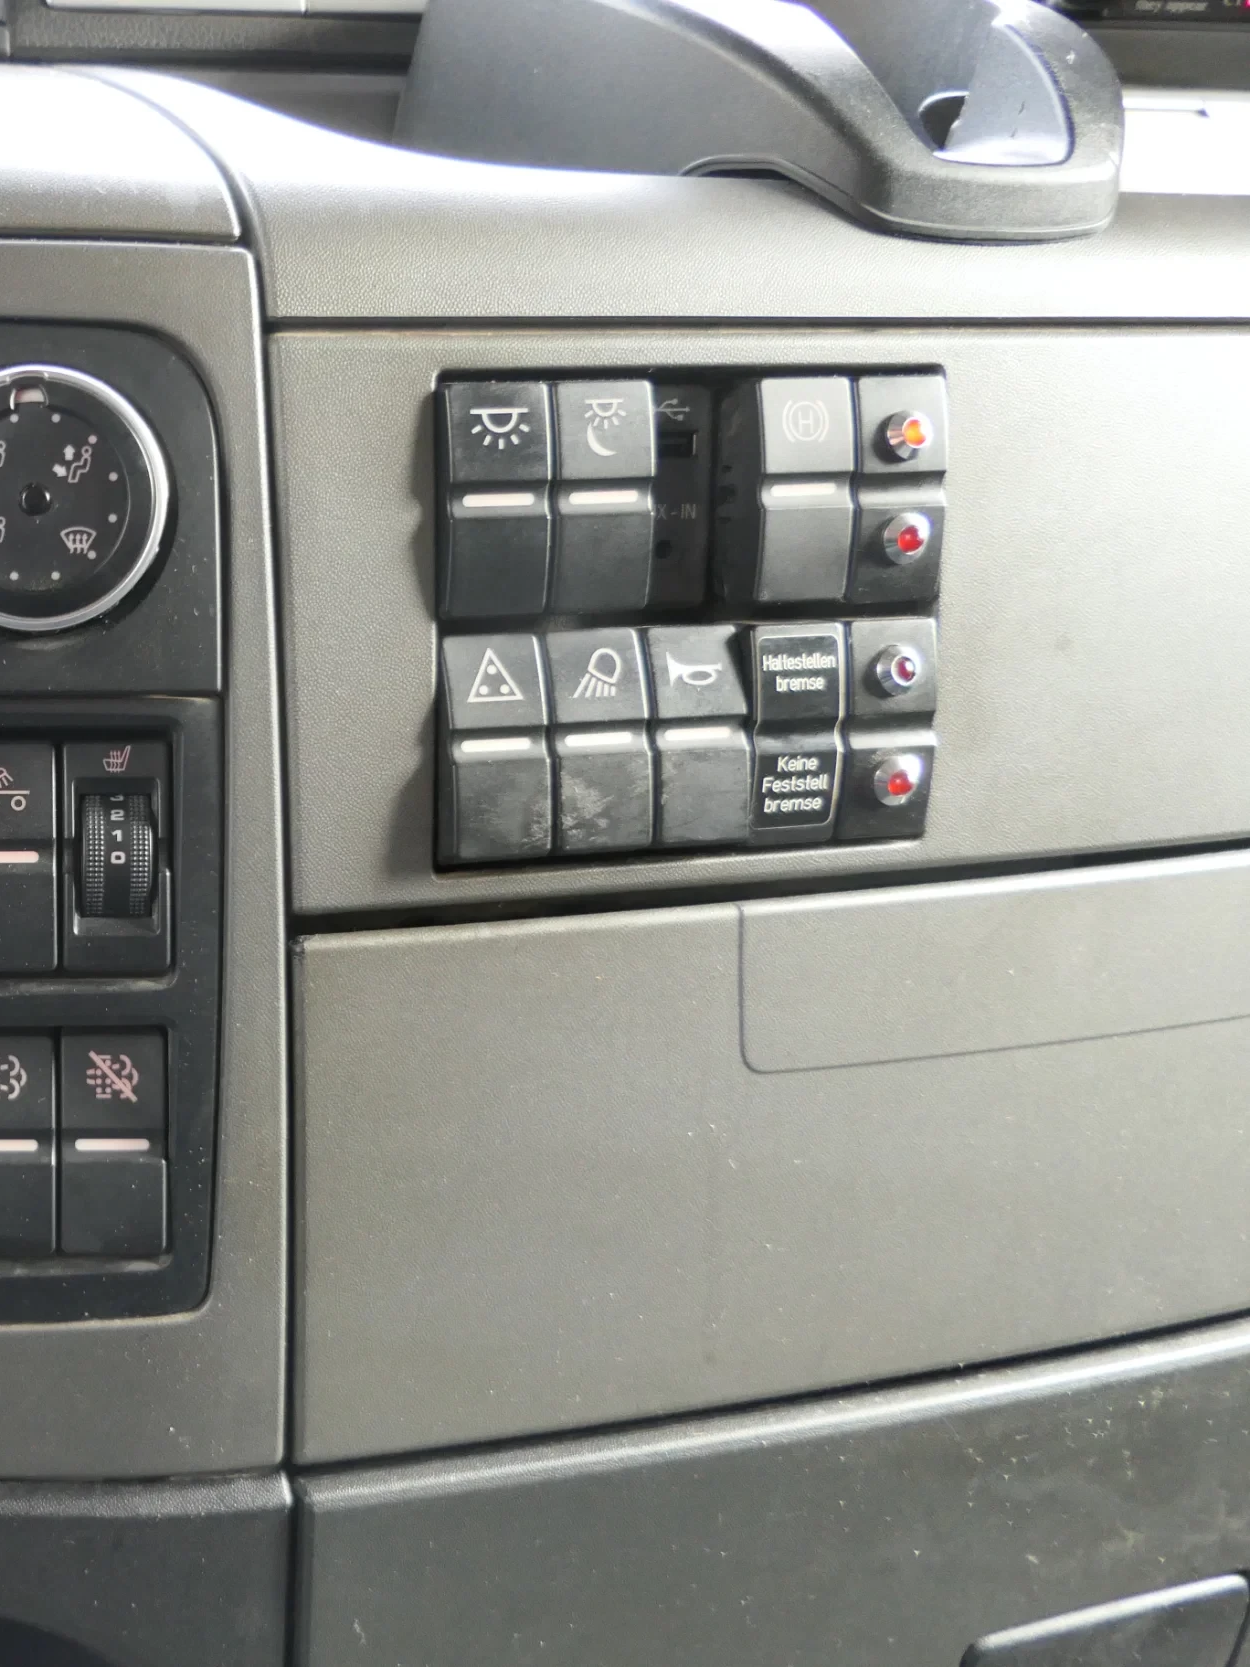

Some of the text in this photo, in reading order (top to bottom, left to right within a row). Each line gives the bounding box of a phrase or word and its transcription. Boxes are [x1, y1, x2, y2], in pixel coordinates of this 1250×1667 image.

[762, 652, 837, 671] Haltestellen
[776, 675, 825, 692] bremse
[777, 755, 819, 772] Keine
[762, 773, 829, 793] Feststell
[763, 796, 822, 813] bremse
[110, 809, 125, 821] 2
[111, 829, 123, 842] 1
[110, 851, 126, 865] 0
